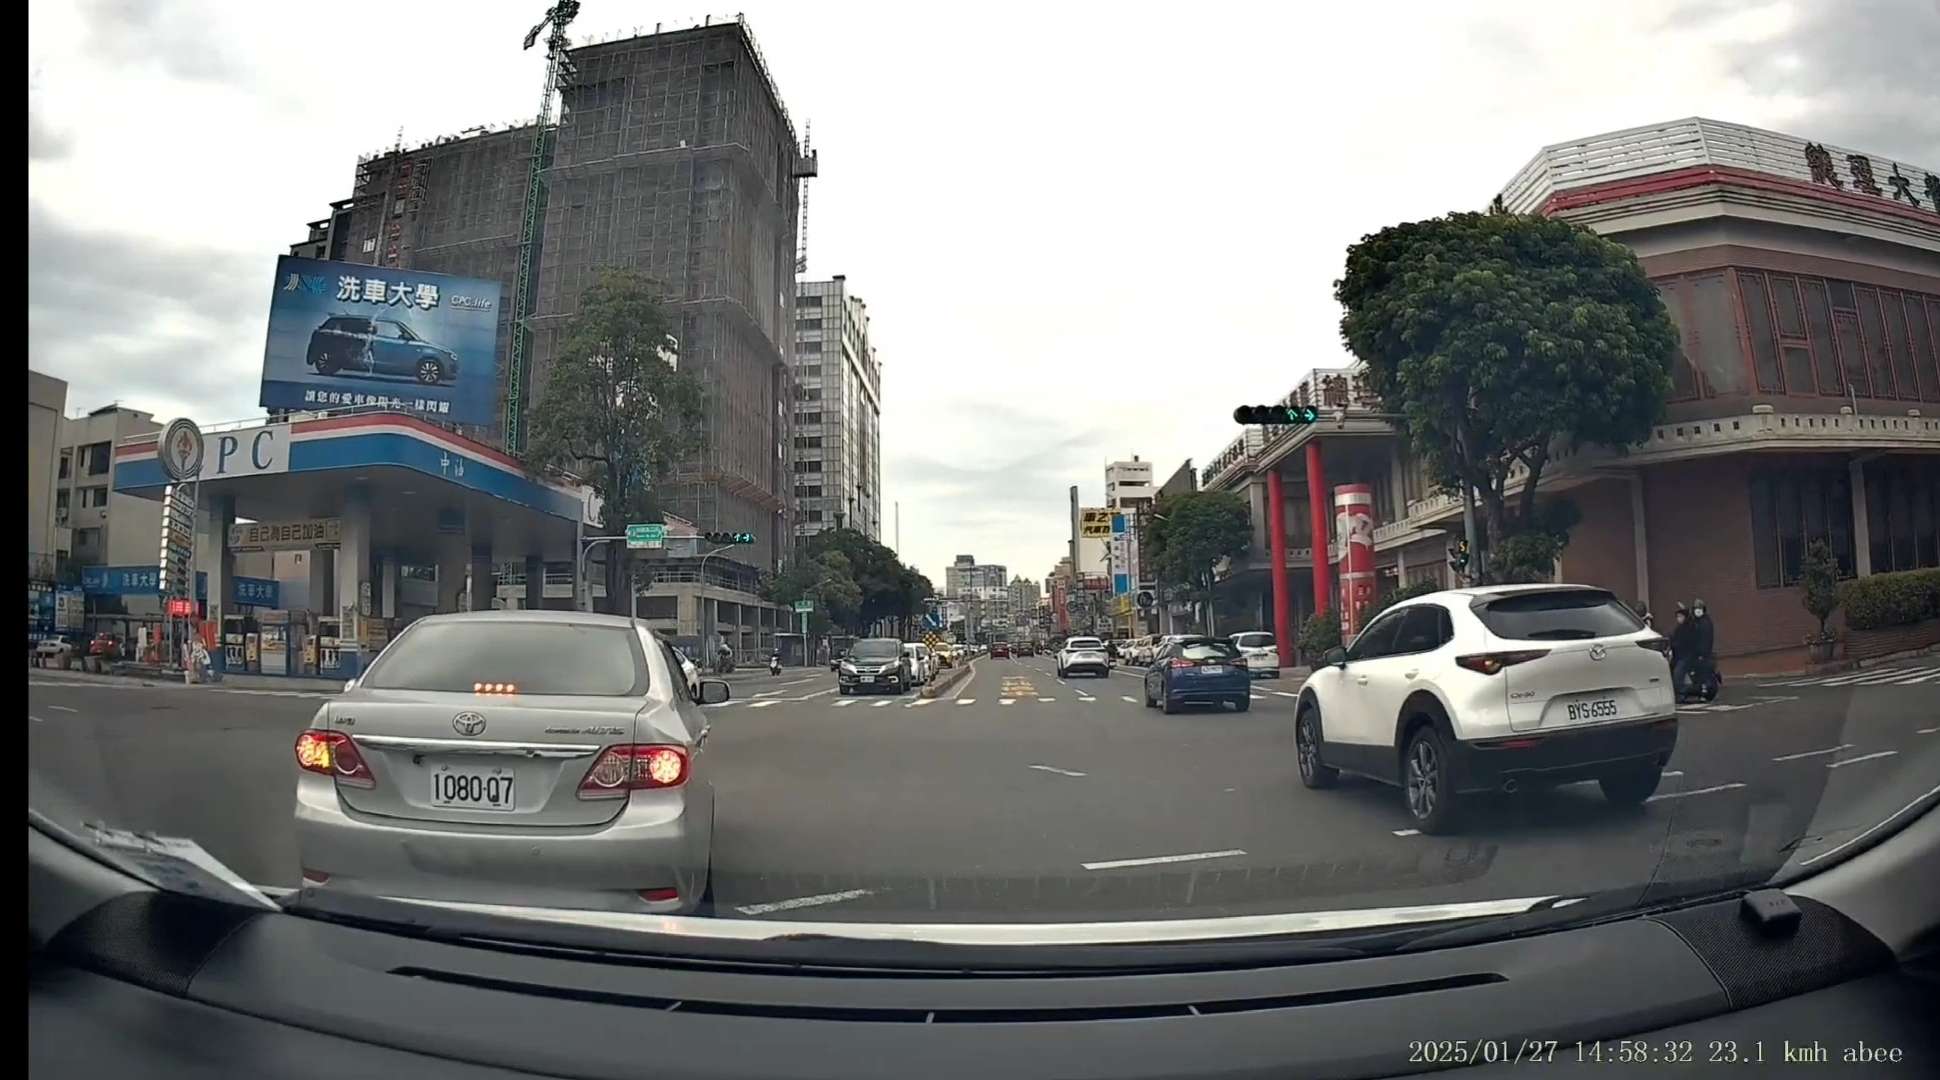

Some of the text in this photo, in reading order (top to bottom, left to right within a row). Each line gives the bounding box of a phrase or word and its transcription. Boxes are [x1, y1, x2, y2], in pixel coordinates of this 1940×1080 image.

[336, 275, 441, 309] 洗車大學
[216, 430, 274, 474] PC
